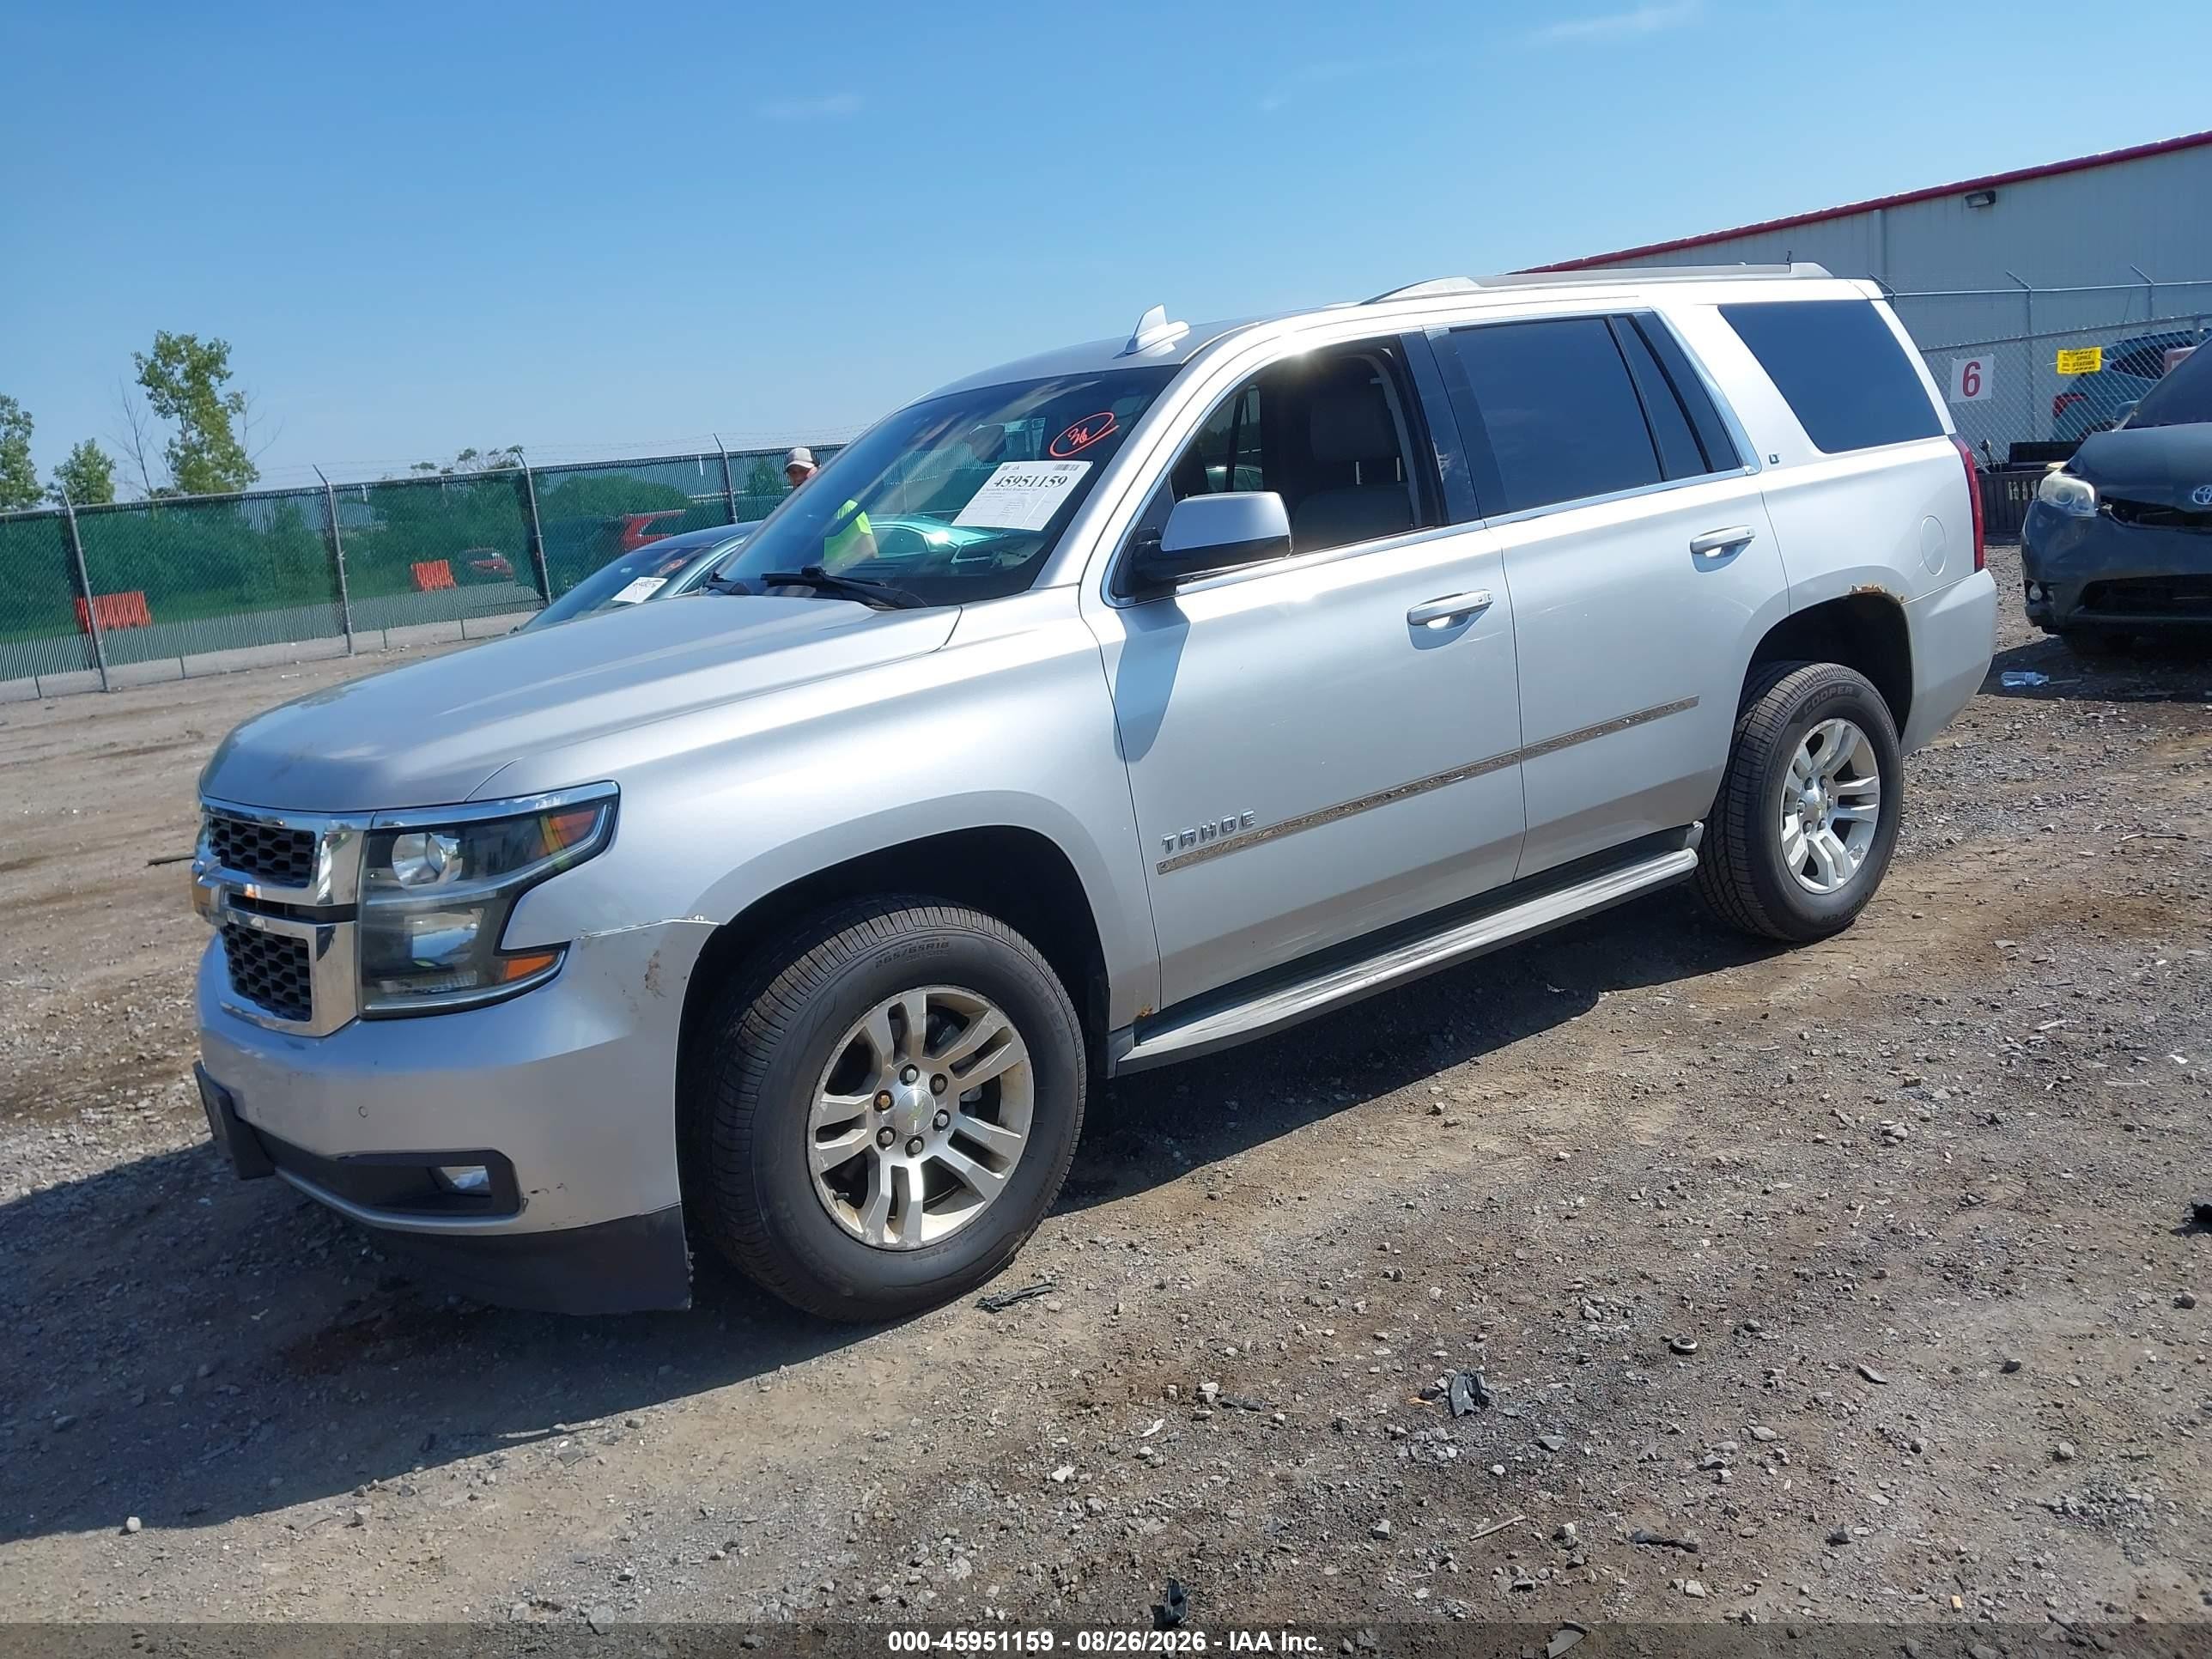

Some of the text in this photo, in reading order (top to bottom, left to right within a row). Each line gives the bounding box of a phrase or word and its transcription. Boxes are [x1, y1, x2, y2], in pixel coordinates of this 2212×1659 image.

[1963, 362, 1981, 397] 6
[994, 475, 1068, 488] 45951159
[1804, 686, 1853, 714] COOPER
[1161, 809, 1256, 854] TAHOE
